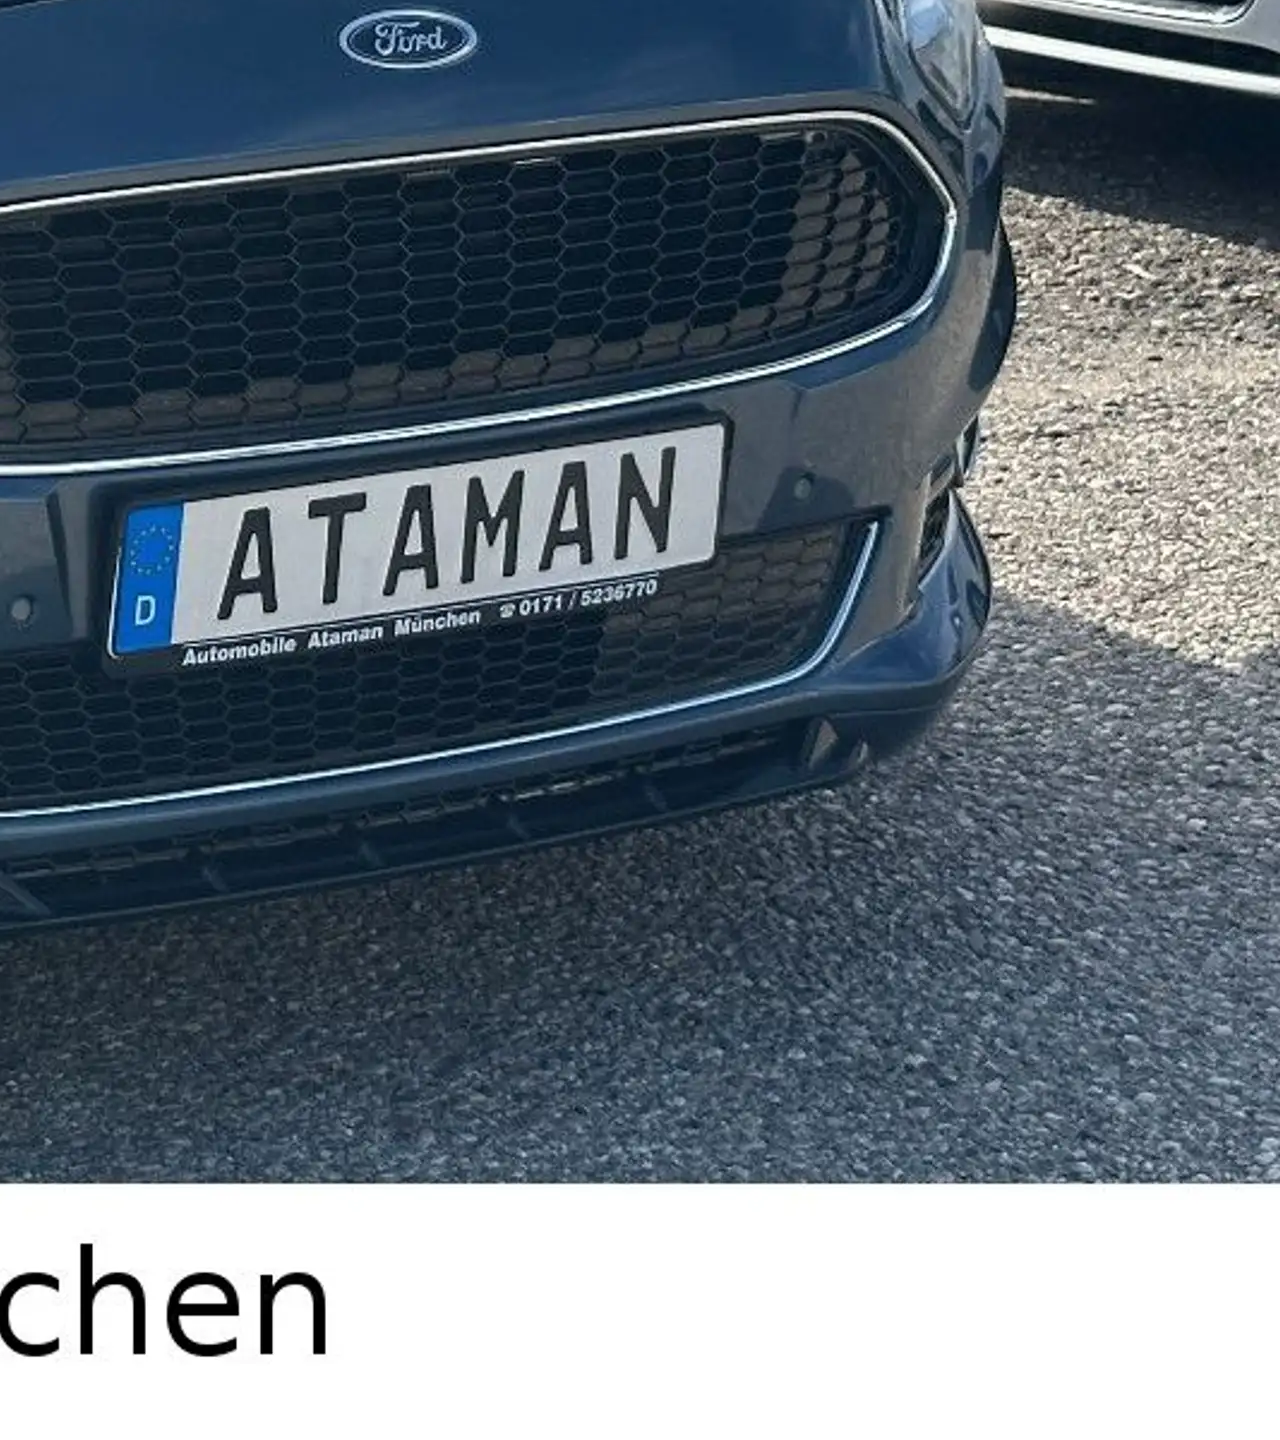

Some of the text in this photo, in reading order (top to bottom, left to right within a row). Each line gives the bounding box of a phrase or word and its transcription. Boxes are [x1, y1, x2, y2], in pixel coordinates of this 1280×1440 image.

[374, 21, 448, 57] Ford
[216, 446, 677, 621] ATAMAN
[134, 595, 157, 626] D
[181, 579, 658, 667] Automobile Ataman München 0171 / 5236770
